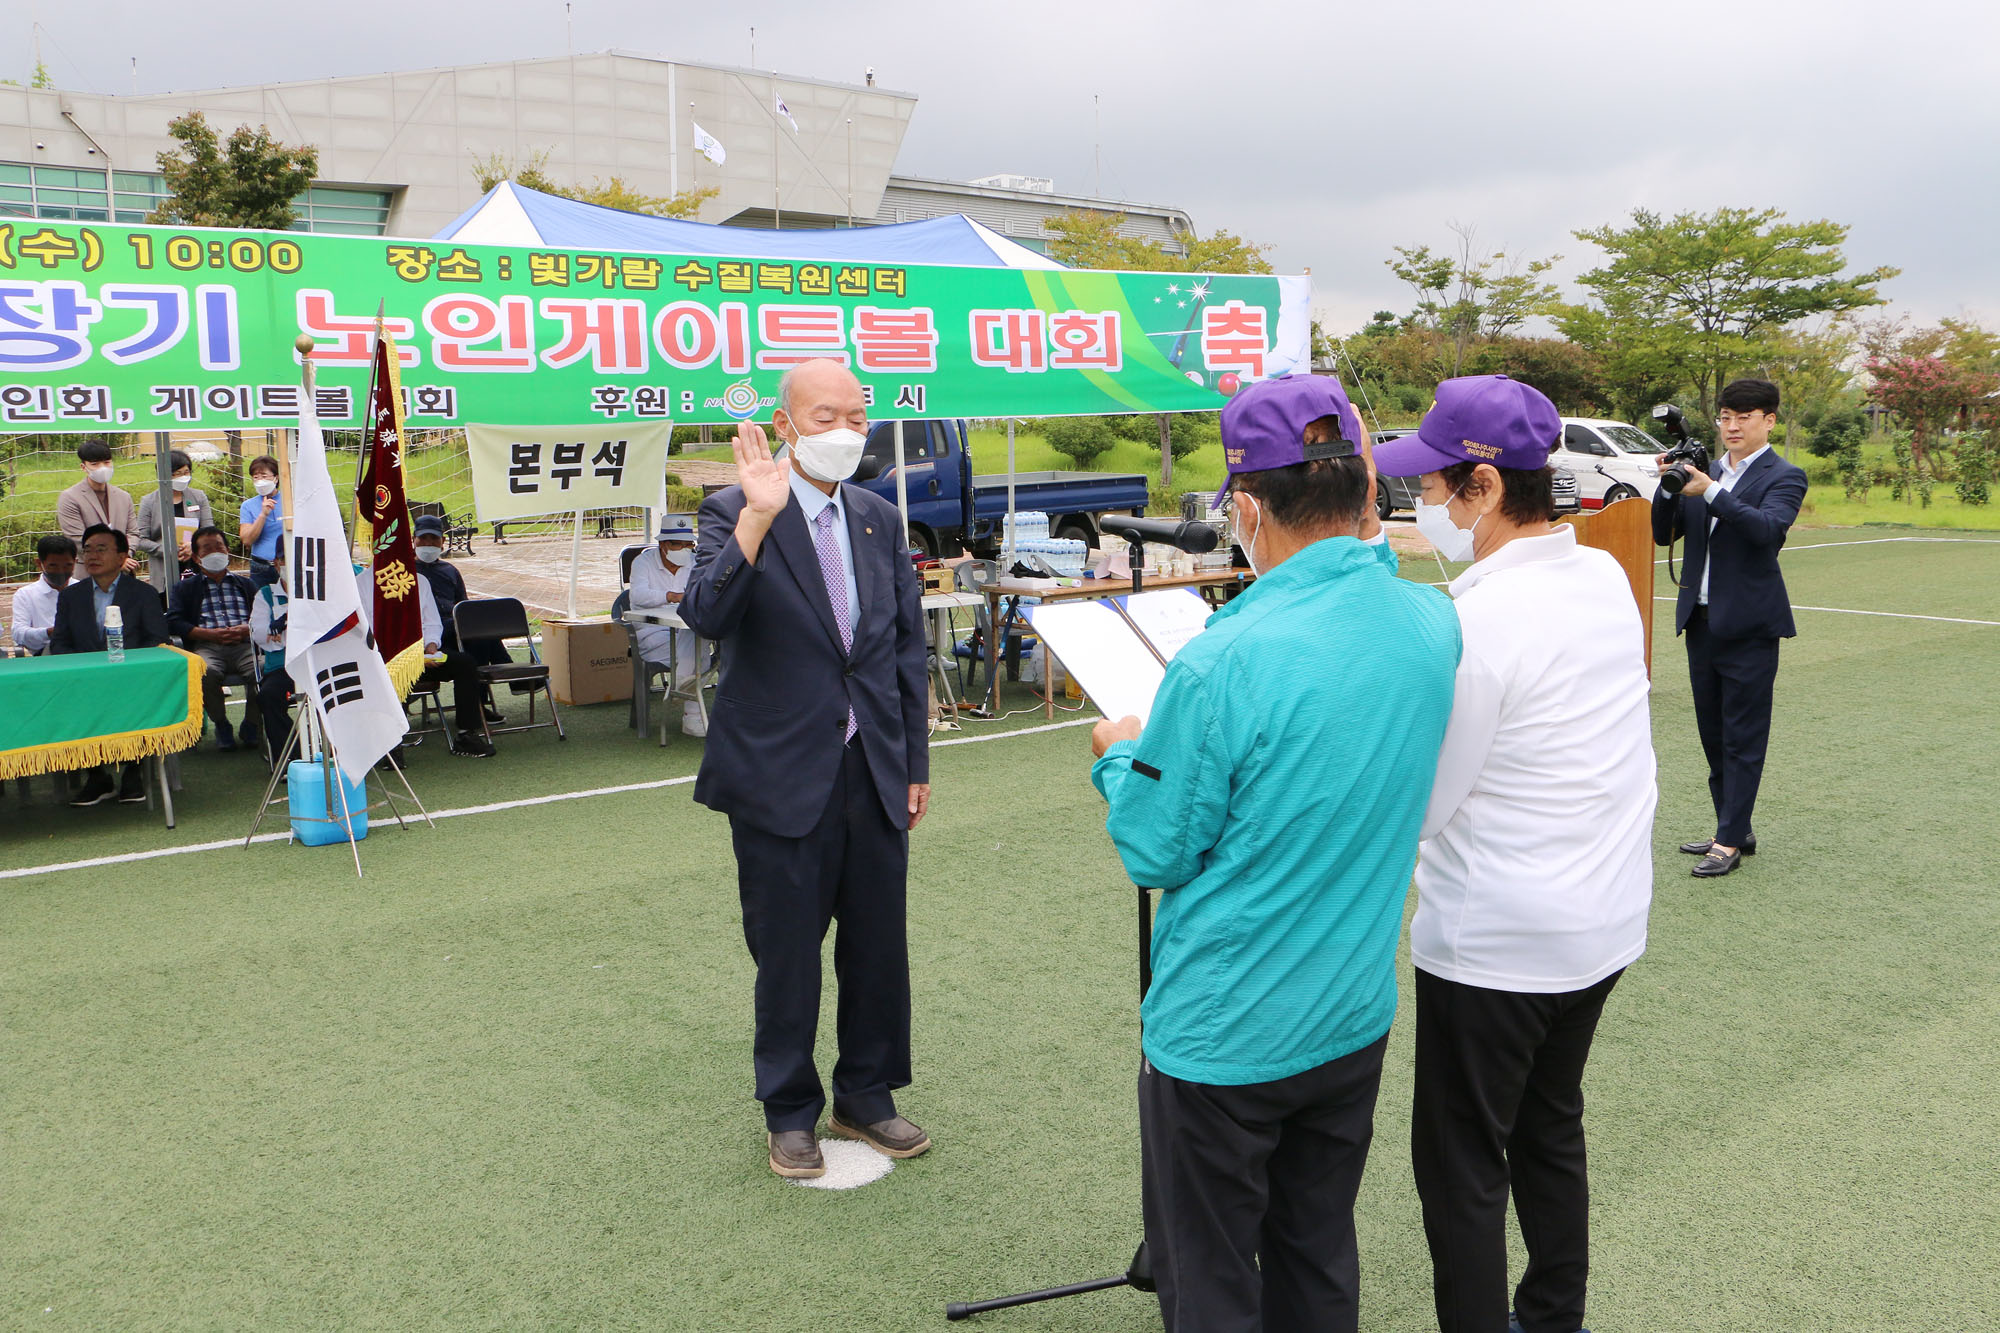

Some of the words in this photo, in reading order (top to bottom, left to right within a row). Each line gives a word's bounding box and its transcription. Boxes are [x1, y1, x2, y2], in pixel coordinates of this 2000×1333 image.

[0, 224, 104, 271] (수)
[128, 233, 303, 274] 10:00
[386, 245, 483, 283] 장소
[529, 253, 663, 291] 빛가람
[675, 261, 907, 298] 수질복원센터
[300, 292, 936, 371] 노인게이트볼
[972, 311, 1120, 369] 대회
[1206, 306, 1265, 377] 축
[594, 387, 668, 416] 후원
[508, 440, 626, 494] 본부석
